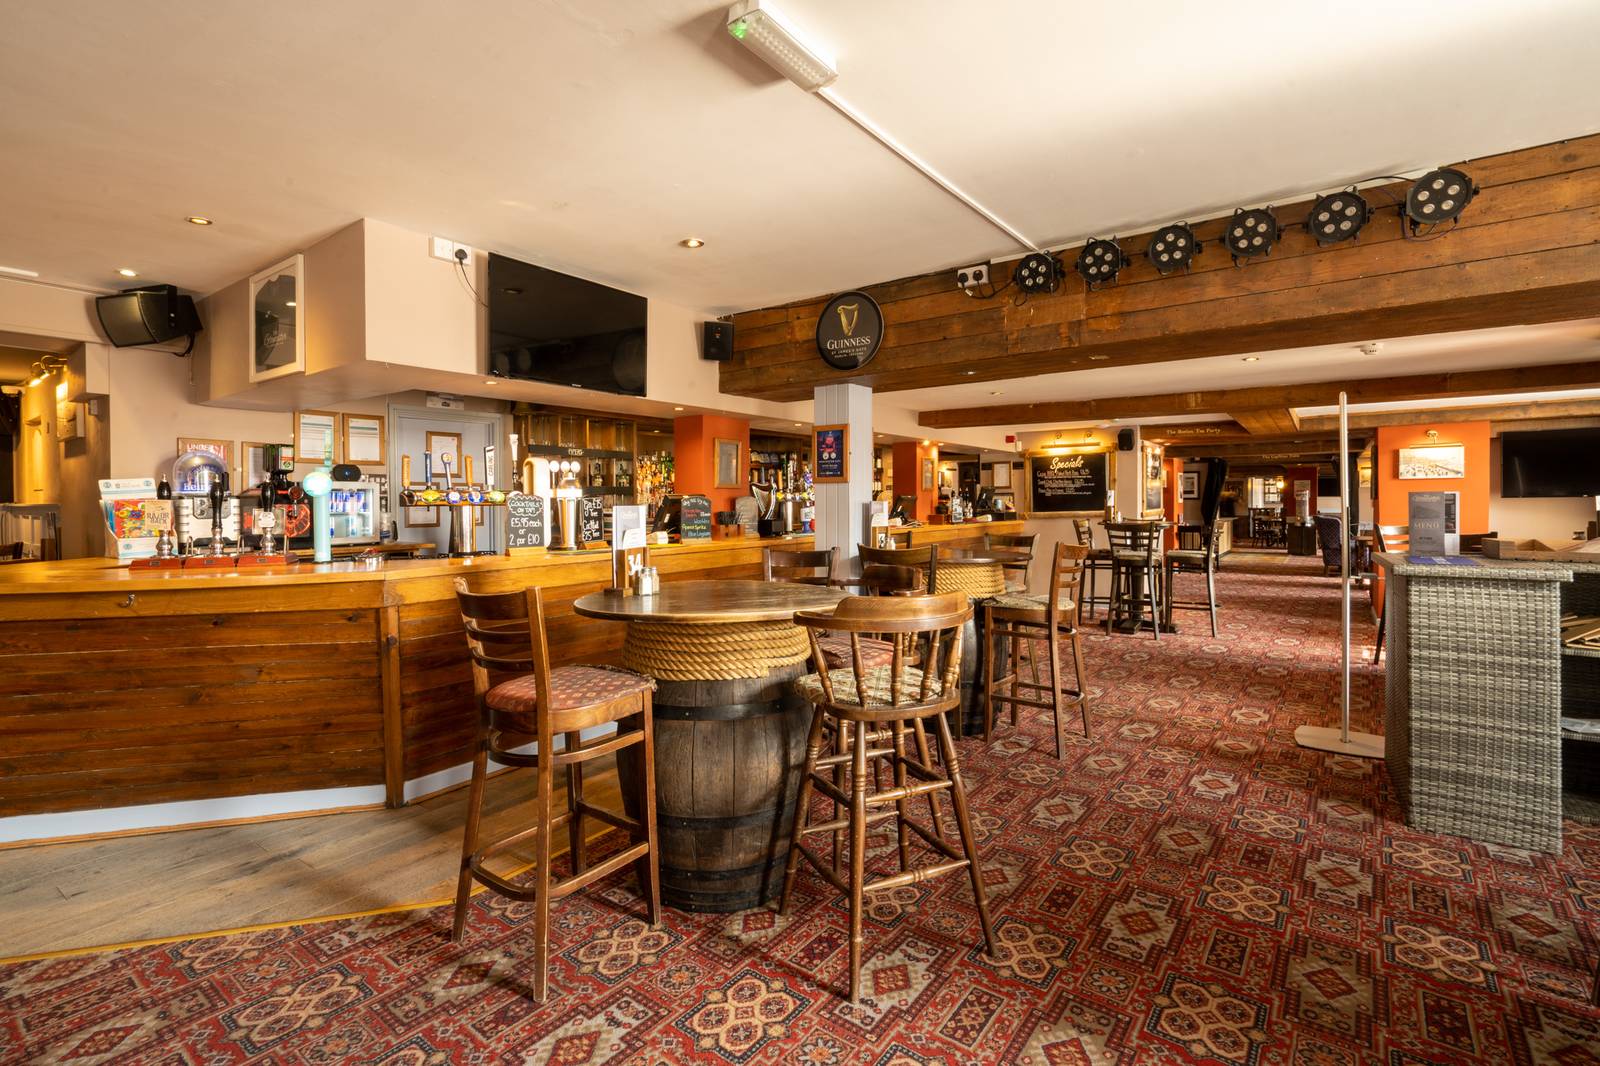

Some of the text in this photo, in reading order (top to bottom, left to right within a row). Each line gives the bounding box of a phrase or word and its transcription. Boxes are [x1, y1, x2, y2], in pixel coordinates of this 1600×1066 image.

[827, 336, 871, 350] GUINNESS
[1050, 456, 1084, 473] Specials
[511, 500, 541, 508] COCKTAILS
[511, 517, 542, 527] £5.95 each
[527, 533, 540, 544] £10
[628, 553, 643, 577] 34
